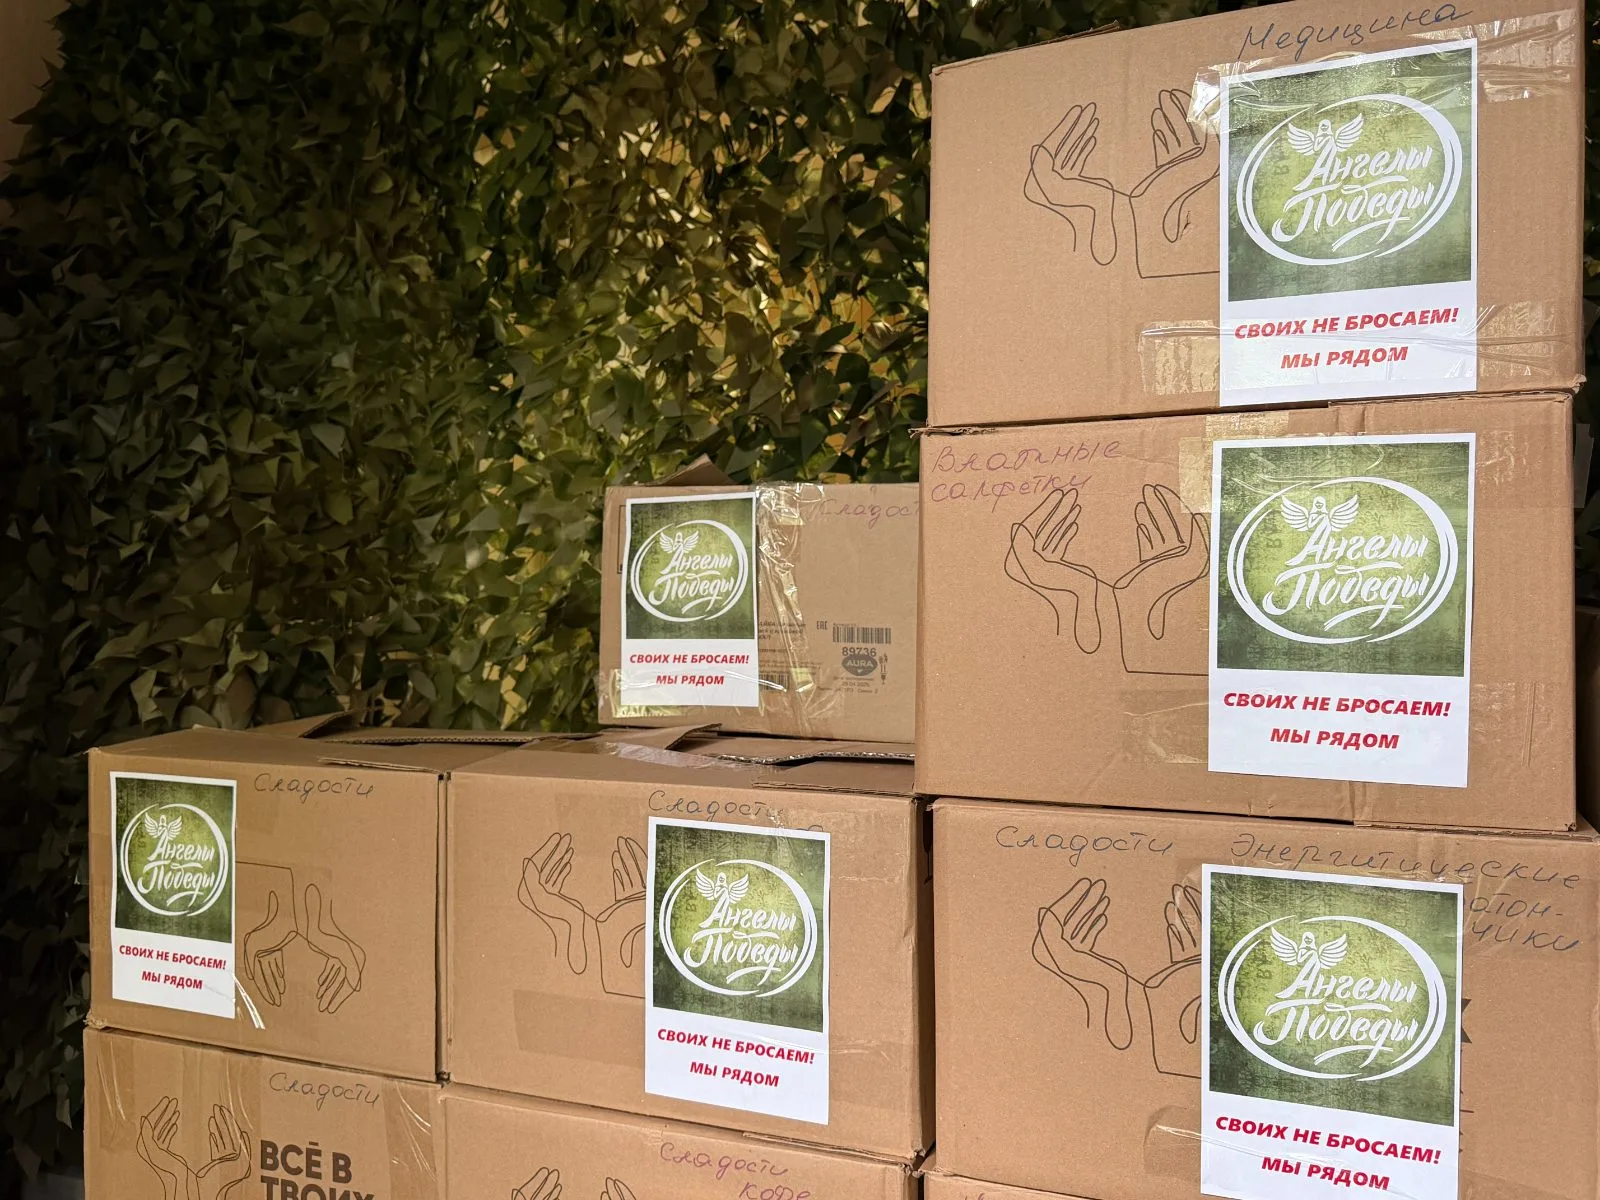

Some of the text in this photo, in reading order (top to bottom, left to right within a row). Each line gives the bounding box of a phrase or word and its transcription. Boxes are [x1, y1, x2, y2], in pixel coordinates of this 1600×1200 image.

[1292, 138, 1433, 191] Ангелы
[1271, 176, 1435, 248] Победы
[1234, 307, 1459, 340] СВОИХ НЕ БРОСАЕМ!
[1280, 346, 1409, 369] МЫ РЯДОМ
[1285, 517, 1429, 566] Ангелы
[660, 546, 734, 575] Ангелы
[648, 570, 735, 614] Победы
[1262, 561, 1430, 632] Победы
[630, 654, 670, 664] СВОИХ
[672, 654, 688, 664] НЕ
[690, 654, 749, 664] БРОСАЕМ!
[847, 659, 874, 667] AURA
[656, 675, 725, 687] МЫ РЯДОМ
[1223, 692, 1452, 717] СВОИХ НЕ БРОСАЕМ!
[1270, 728, 1400, 751] МЫ РЯДОМ
[254, 772, 375, 804] Сладости
[148, 834, 215, 861] Ангелы
[995, 825, 1173, 868] Сладости
[137, 861, 216, 908] Победы
[1464, 882, 1563, 917] атон-
[699, 892, 797, 931] Ангелы
[119, 945, 227, 970] СВОИХ НЕ БРОСАЕМ!
[683, 928, 799, 986] Победы
[141, 971, 203, 990] МЫ РЯДОМ
[1275, 952, 1418, 1003] Ангелы
[657, 1028, 815, 1065] СВОИХ НЕ БРОСАЕМ!
[1253, 999, 1419, 1068] Победы
[269, 1072, 380, 1112] Сладости
[689, 1061, 780, 1088] МЫ РЯДОМ
[1215, 1116, 1442, 1165] СВОИХ НЕ БРОСАЕМ!
[332, 1151, 353, 1184] В
[660, 1142, 788, 1180] Сладости
[1261, 1156, 1390, 1191] МЫ РЯДОМ
[260, 1175, 375, 1200] ТВО
